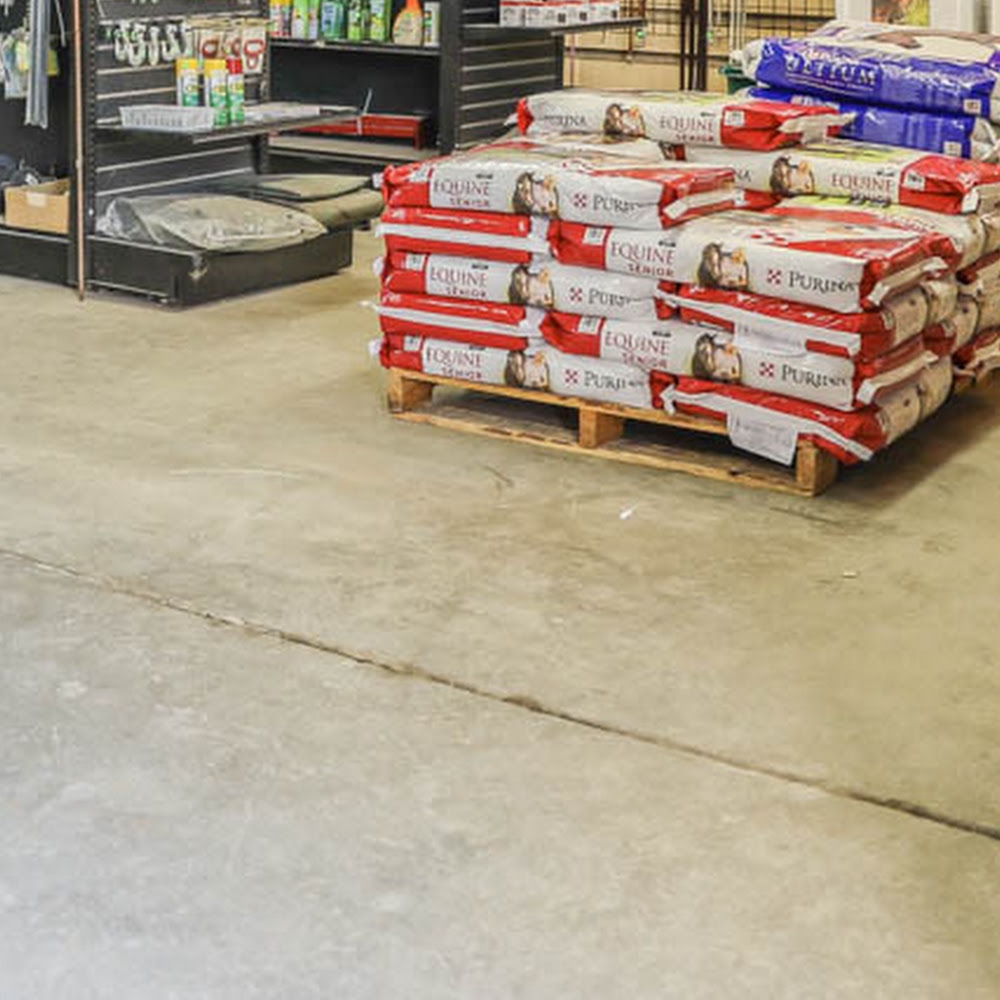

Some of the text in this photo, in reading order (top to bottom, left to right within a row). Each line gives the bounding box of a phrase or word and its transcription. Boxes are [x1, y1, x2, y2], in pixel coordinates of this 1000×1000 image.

[659, 114, 713, 133] EQUINE
[433, 178, 490, 197] EQUINE
[831, 172, 893, 192] EQUINE
[449, 197, 490, 208] SENIOR
[610, 240, 677, 266] EQUINE
[430, 265, 488, 288] EQUINE
[627, 262, 675, 276] SENIOR
[445, 286, 487, 298] SENIOR
[788, 270, 857, 295] PURINA
[604, 330, 671, 355] EQUINE
[426, 347, 483, 368] EQUINE
[622, 351, 668, 369] SENIOR
[441, 366, 483, 379] SENIOR
[781, 363, 848, 390] PURINA
